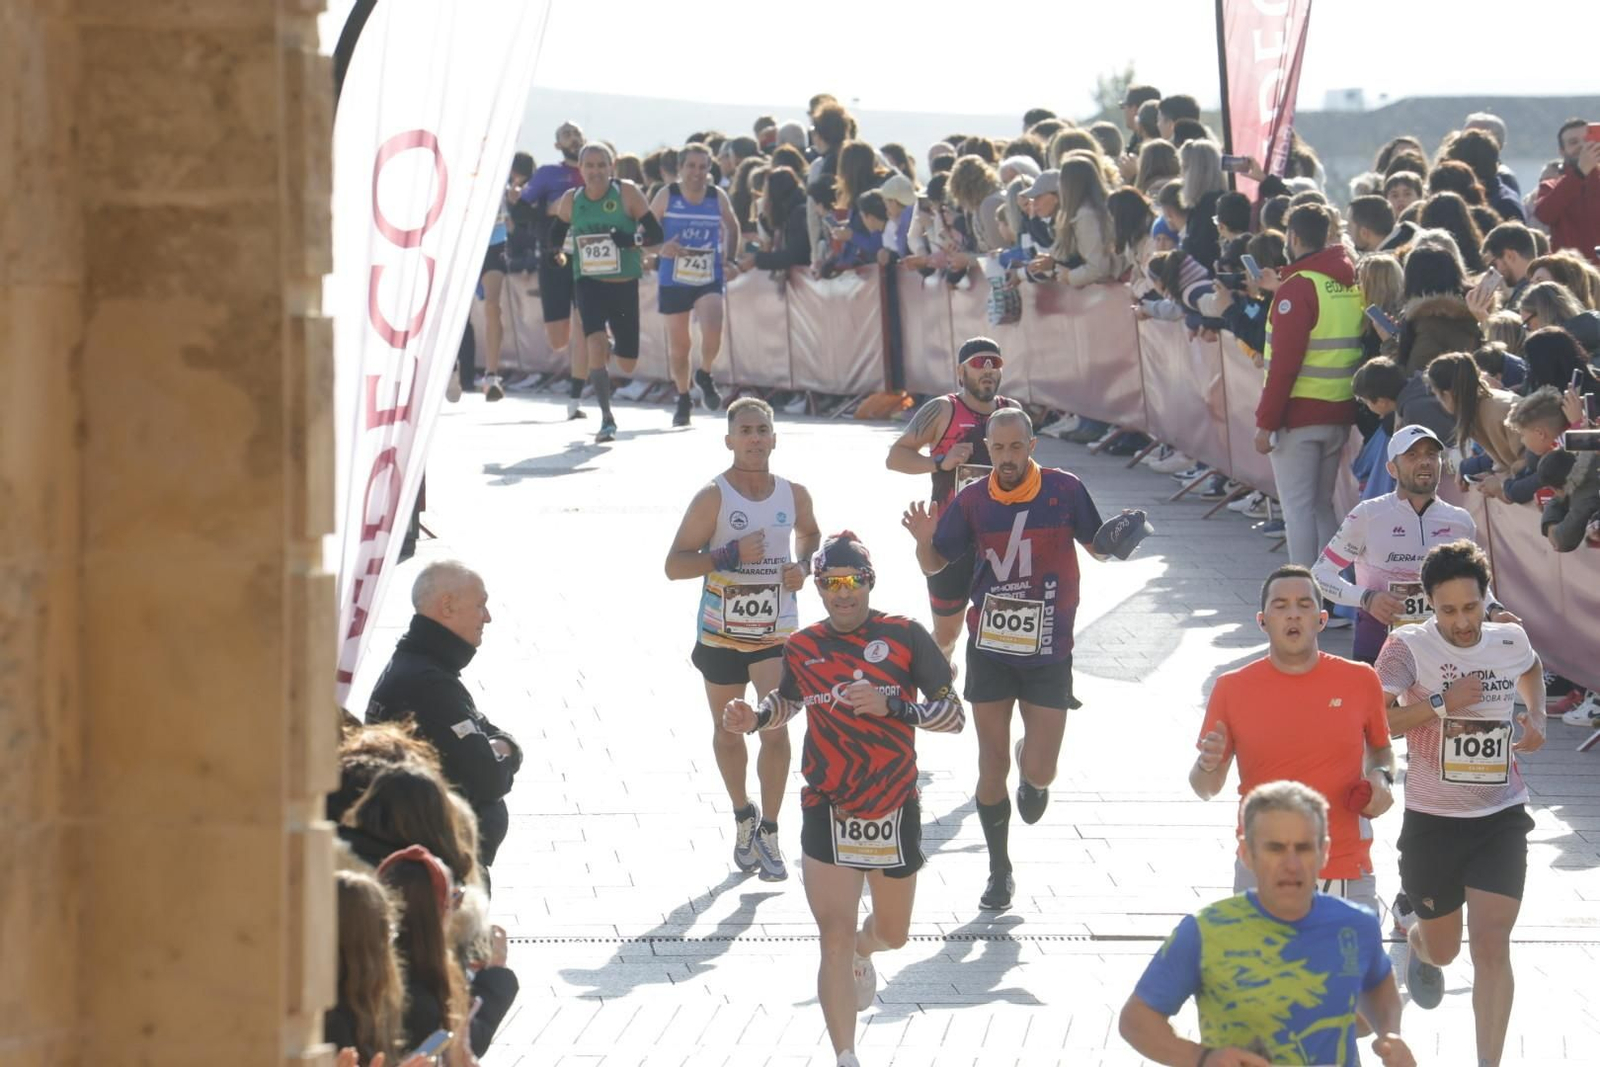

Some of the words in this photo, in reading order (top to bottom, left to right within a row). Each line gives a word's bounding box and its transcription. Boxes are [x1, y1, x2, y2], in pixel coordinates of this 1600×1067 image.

[585, 245, 611, 258] 982
[731, 599, 773, 617] 404
[985, 610, 1036, 633] 1005
[874, 685, 901, 697] PORT
[1481, 676, 1515, 692] RATÓN
[1453, 736, 1503, 758] 1081
[838, 820, 893, 840] 1800
